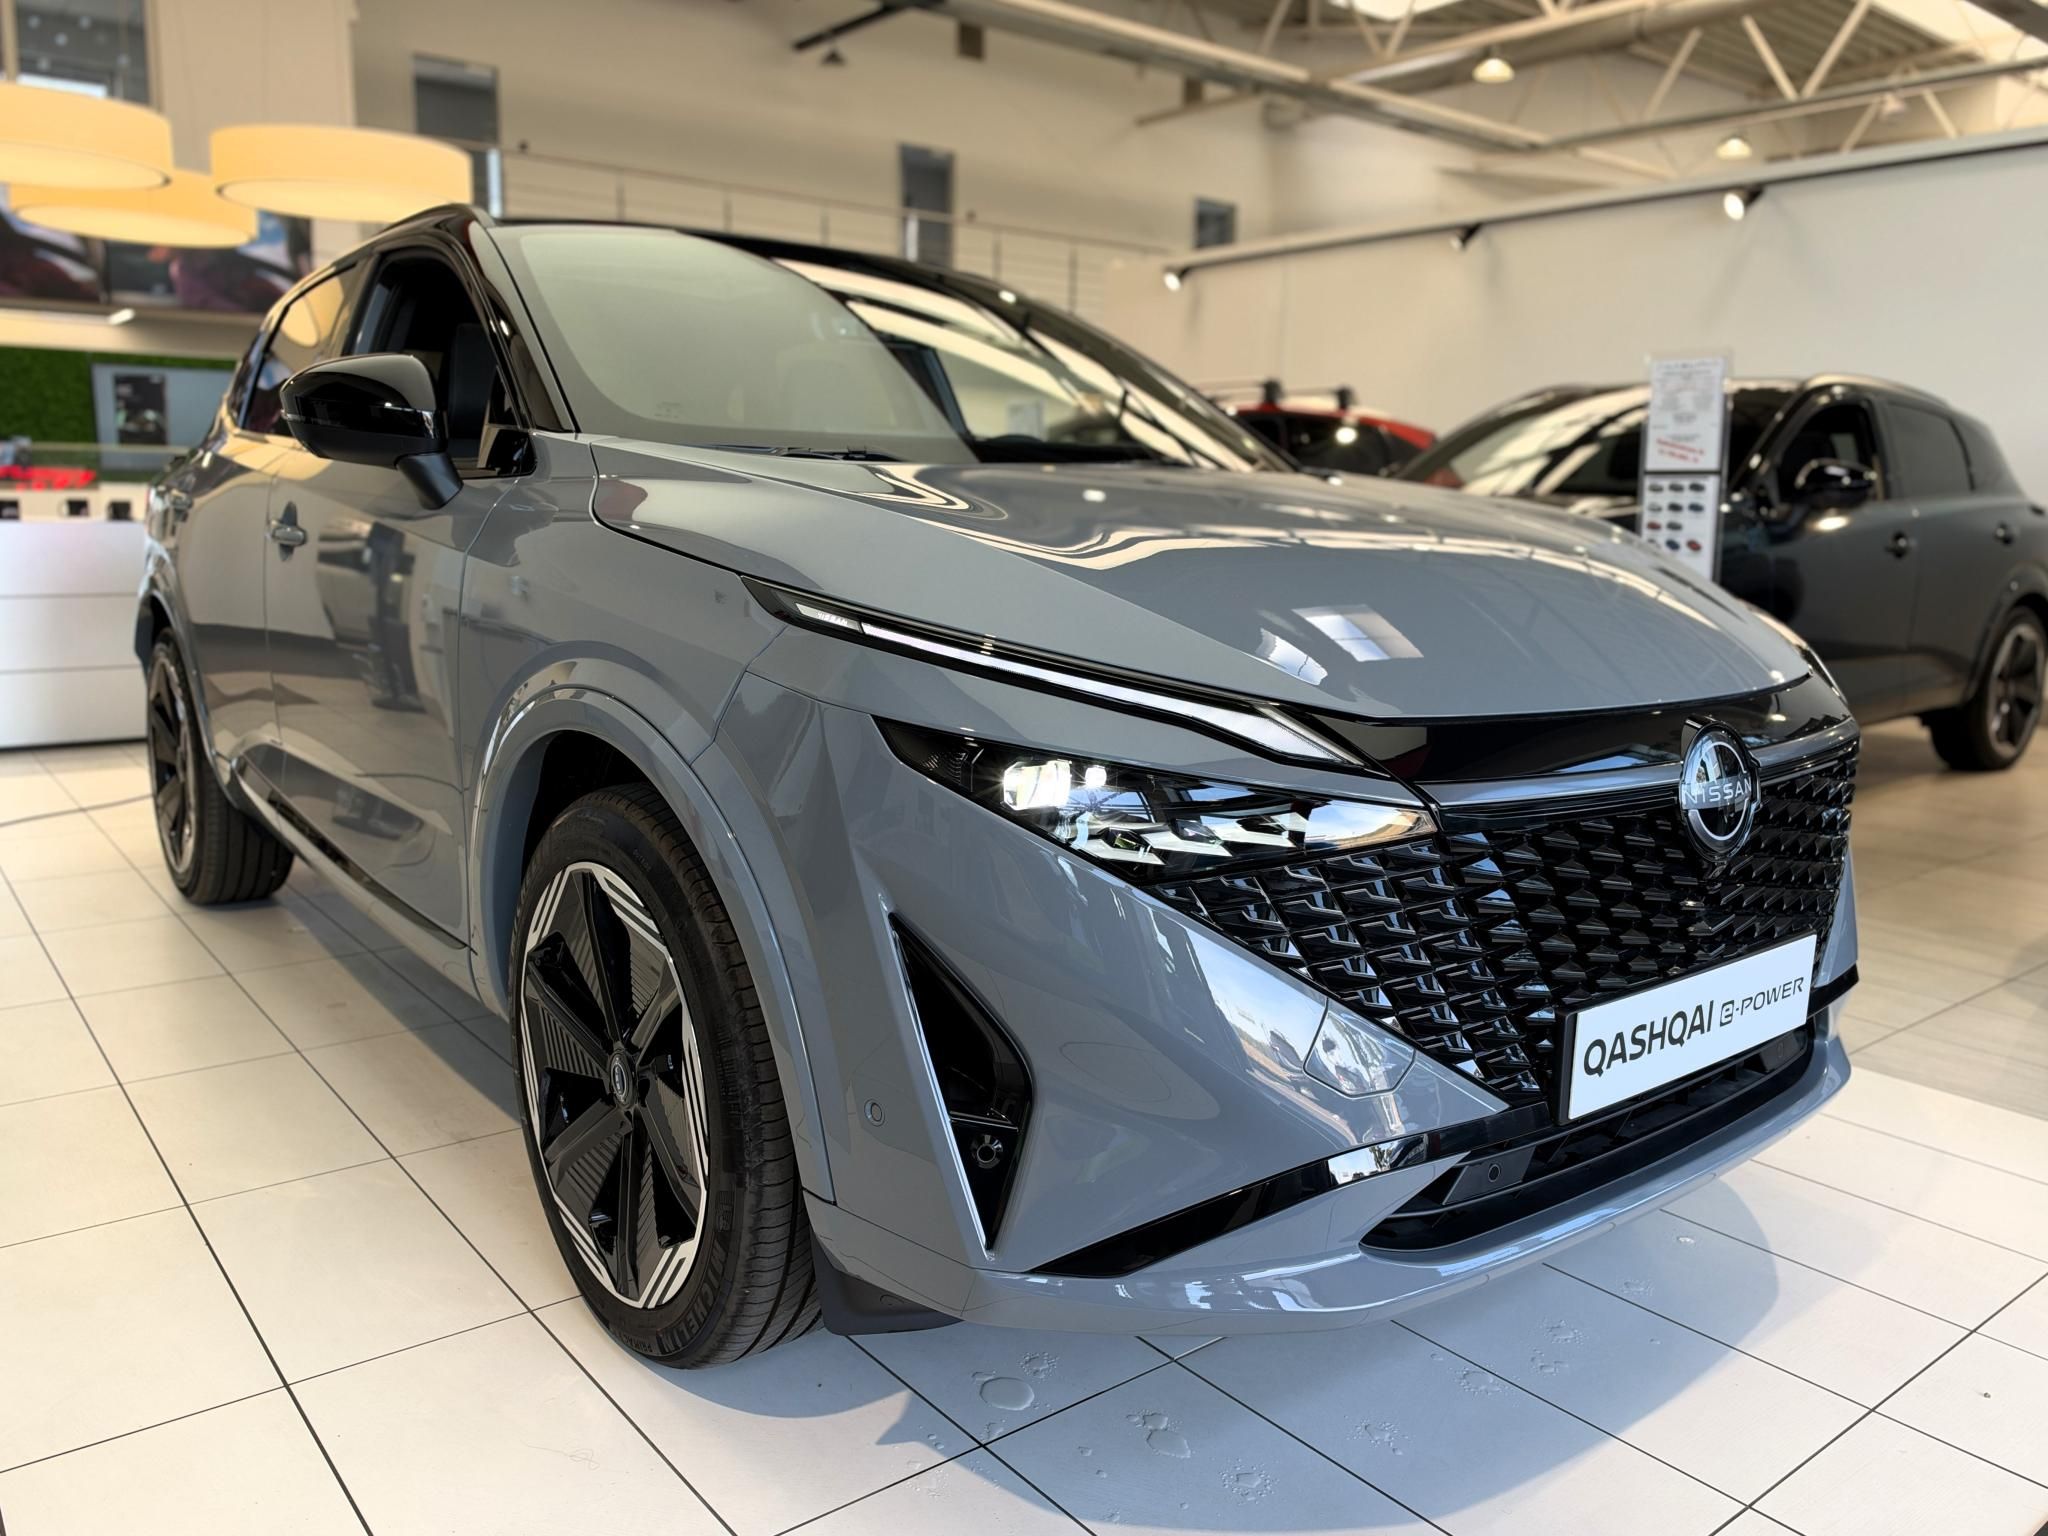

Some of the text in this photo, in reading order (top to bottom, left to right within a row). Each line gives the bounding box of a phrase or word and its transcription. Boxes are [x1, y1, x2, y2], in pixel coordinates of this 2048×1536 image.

[1681, 777, 1752, 805] NISSAN
[1583, 1000, 1714, 1078] QASHQAI
[661, 1238, 728, 1353] MICHELIN
